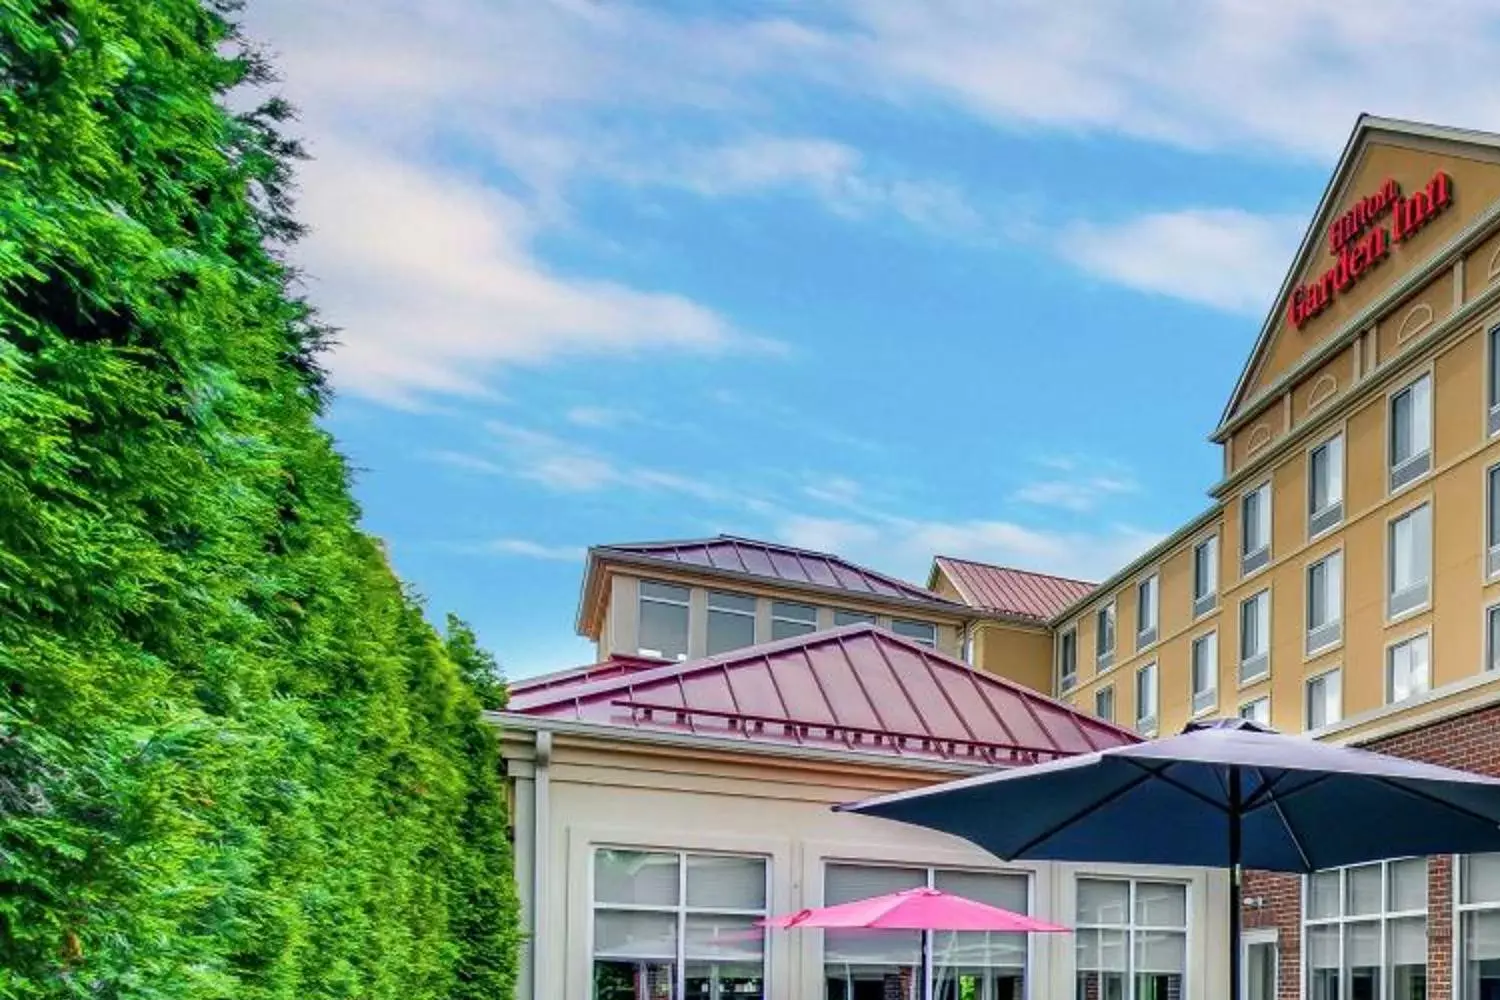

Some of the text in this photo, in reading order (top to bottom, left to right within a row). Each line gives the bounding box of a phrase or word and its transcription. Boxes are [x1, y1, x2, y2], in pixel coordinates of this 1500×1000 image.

[1287, 170, 1451, 329] Garden Inn
[1328, 178, 1399, 255] Hilton
